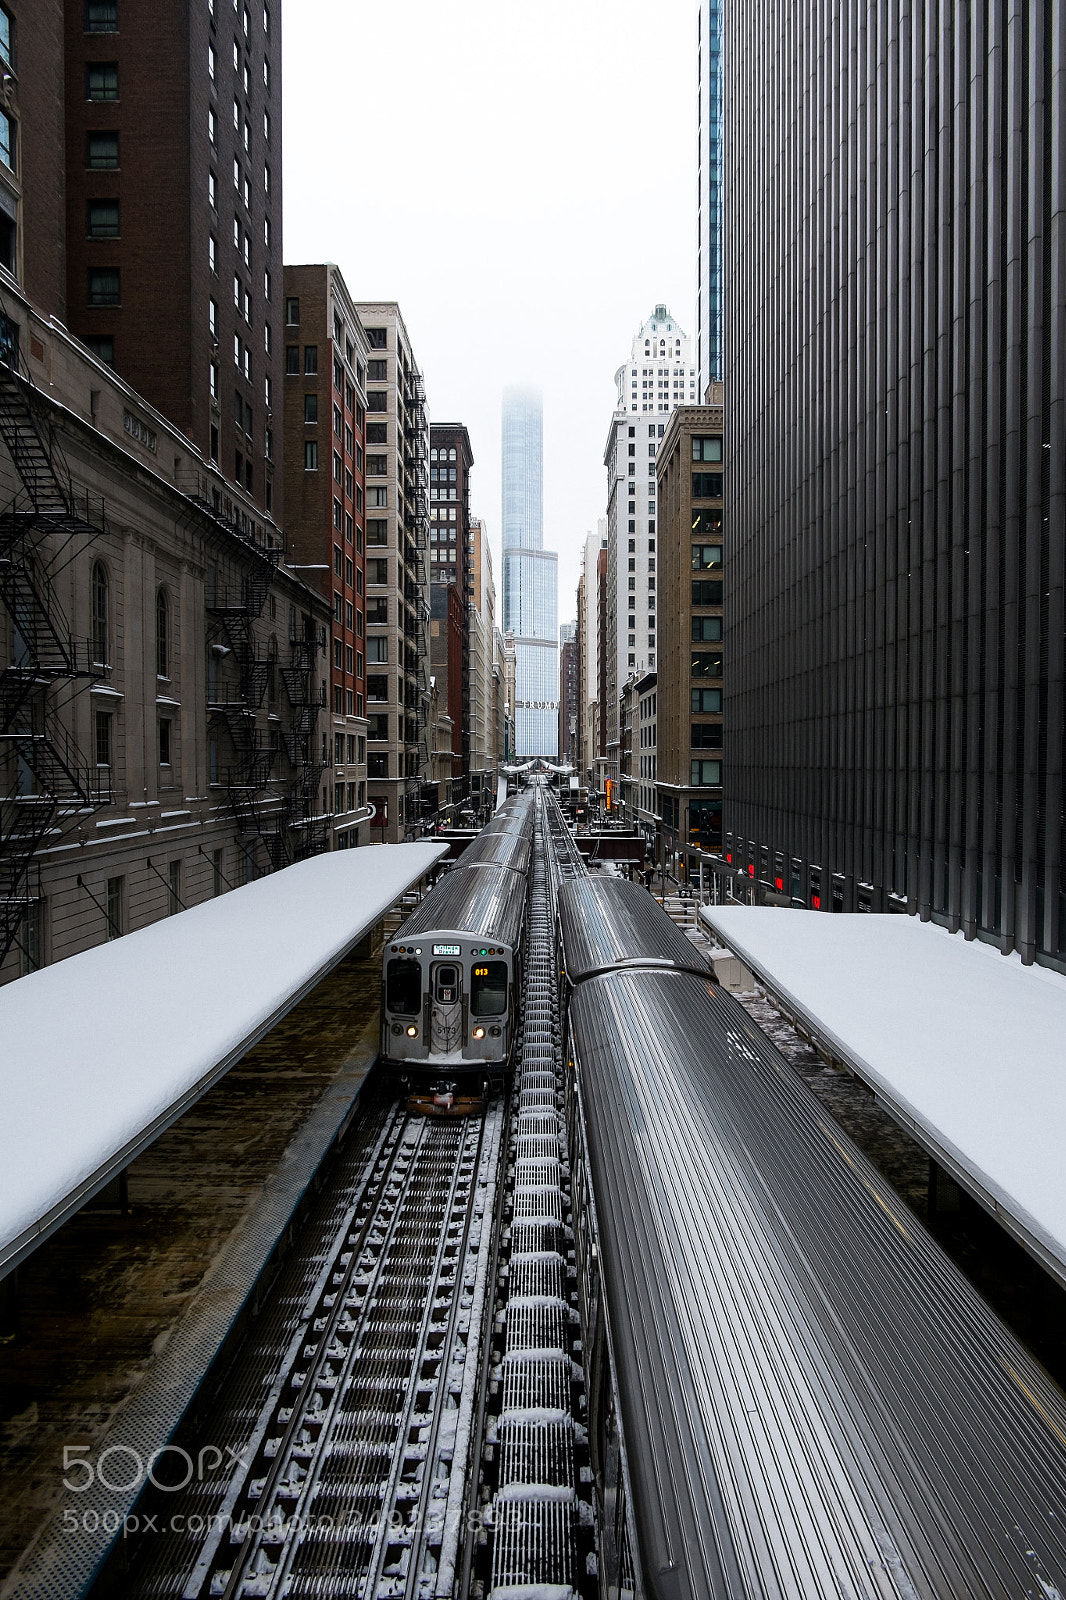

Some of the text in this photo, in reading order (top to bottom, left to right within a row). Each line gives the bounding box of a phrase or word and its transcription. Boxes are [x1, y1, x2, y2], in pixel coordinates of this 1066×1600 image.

[522, 701, 558, 709] TRUMP
[475, 968, 489, 976] 013
[437, 1026, 456, 1034] 5173
